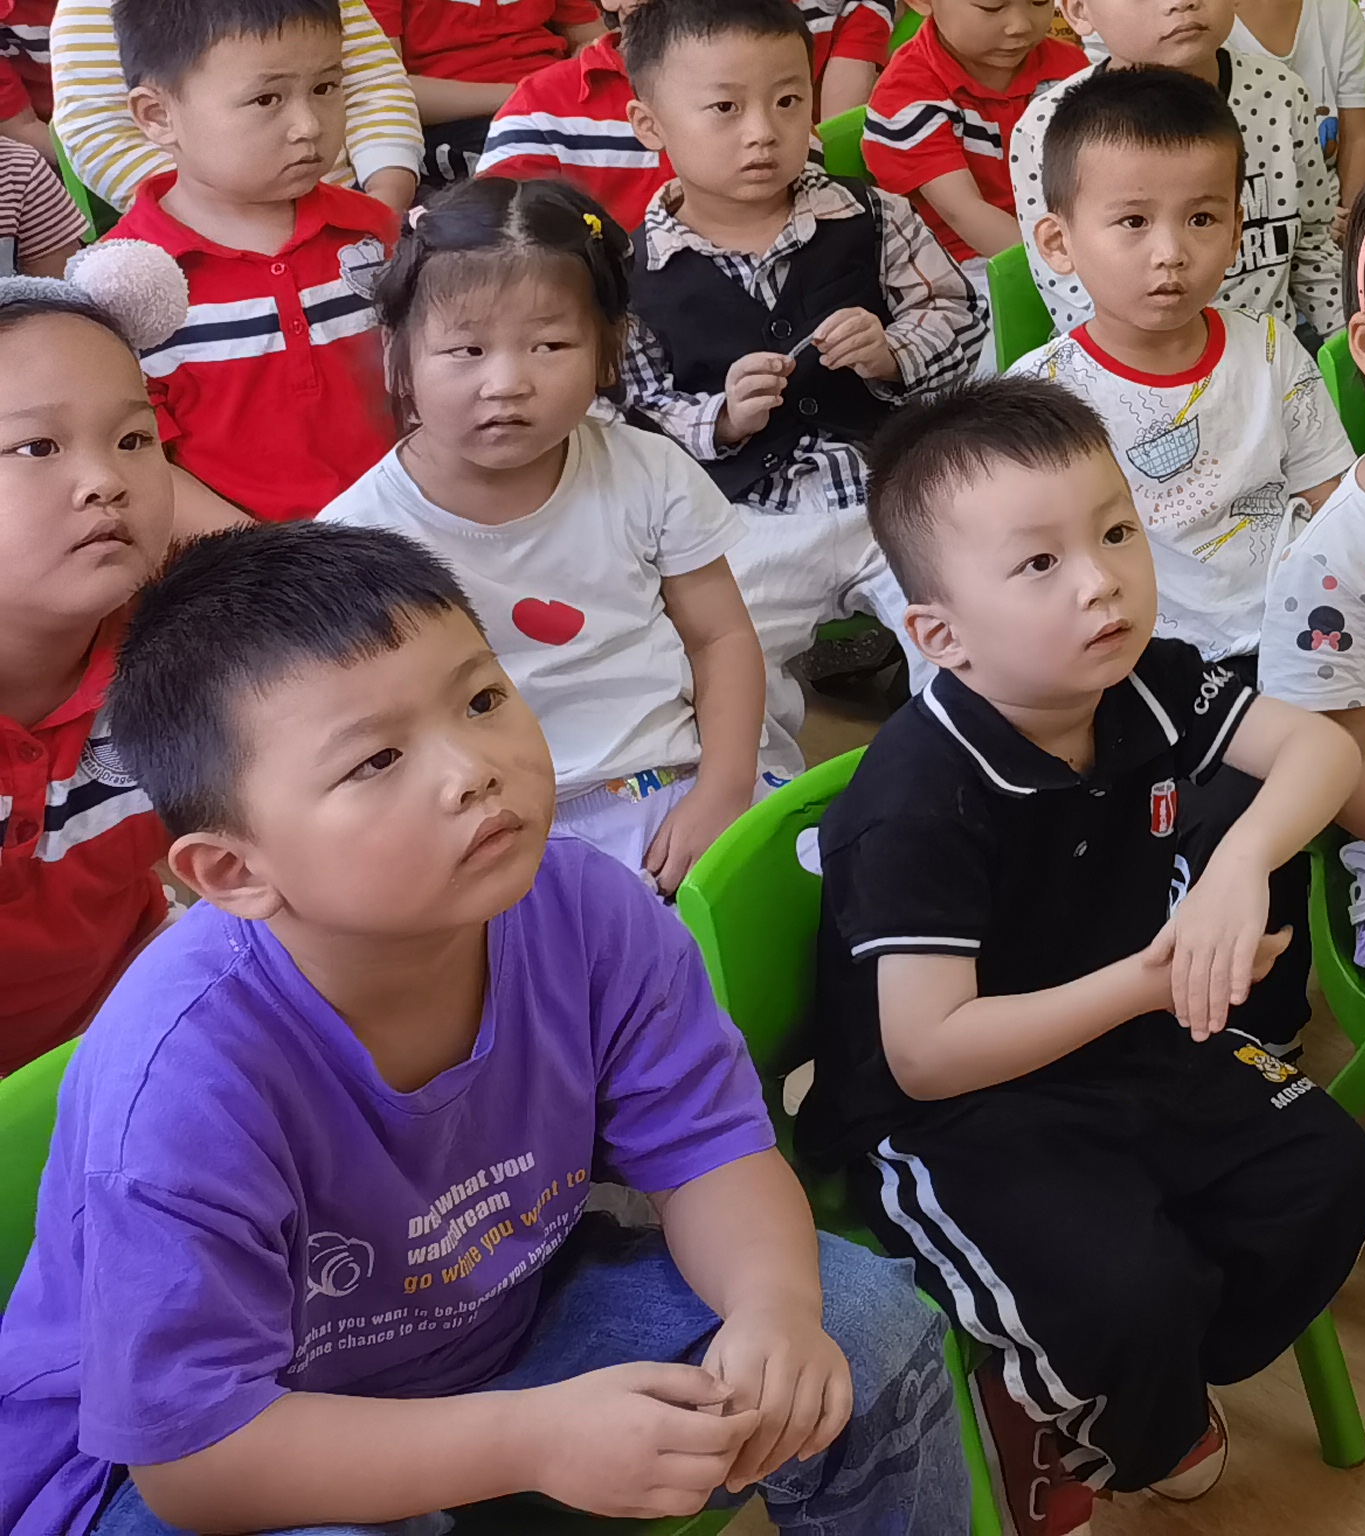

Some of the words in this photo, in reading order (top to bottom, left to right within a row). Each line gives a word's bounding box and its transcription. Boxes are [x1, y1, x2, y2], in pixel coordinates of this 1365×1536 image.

[489, 1152, 535, 1184] you
[404, 1273, 433, 1294] go
[480, 1220, 514, 1256] you
[567, 1169, 586, 1188] to
